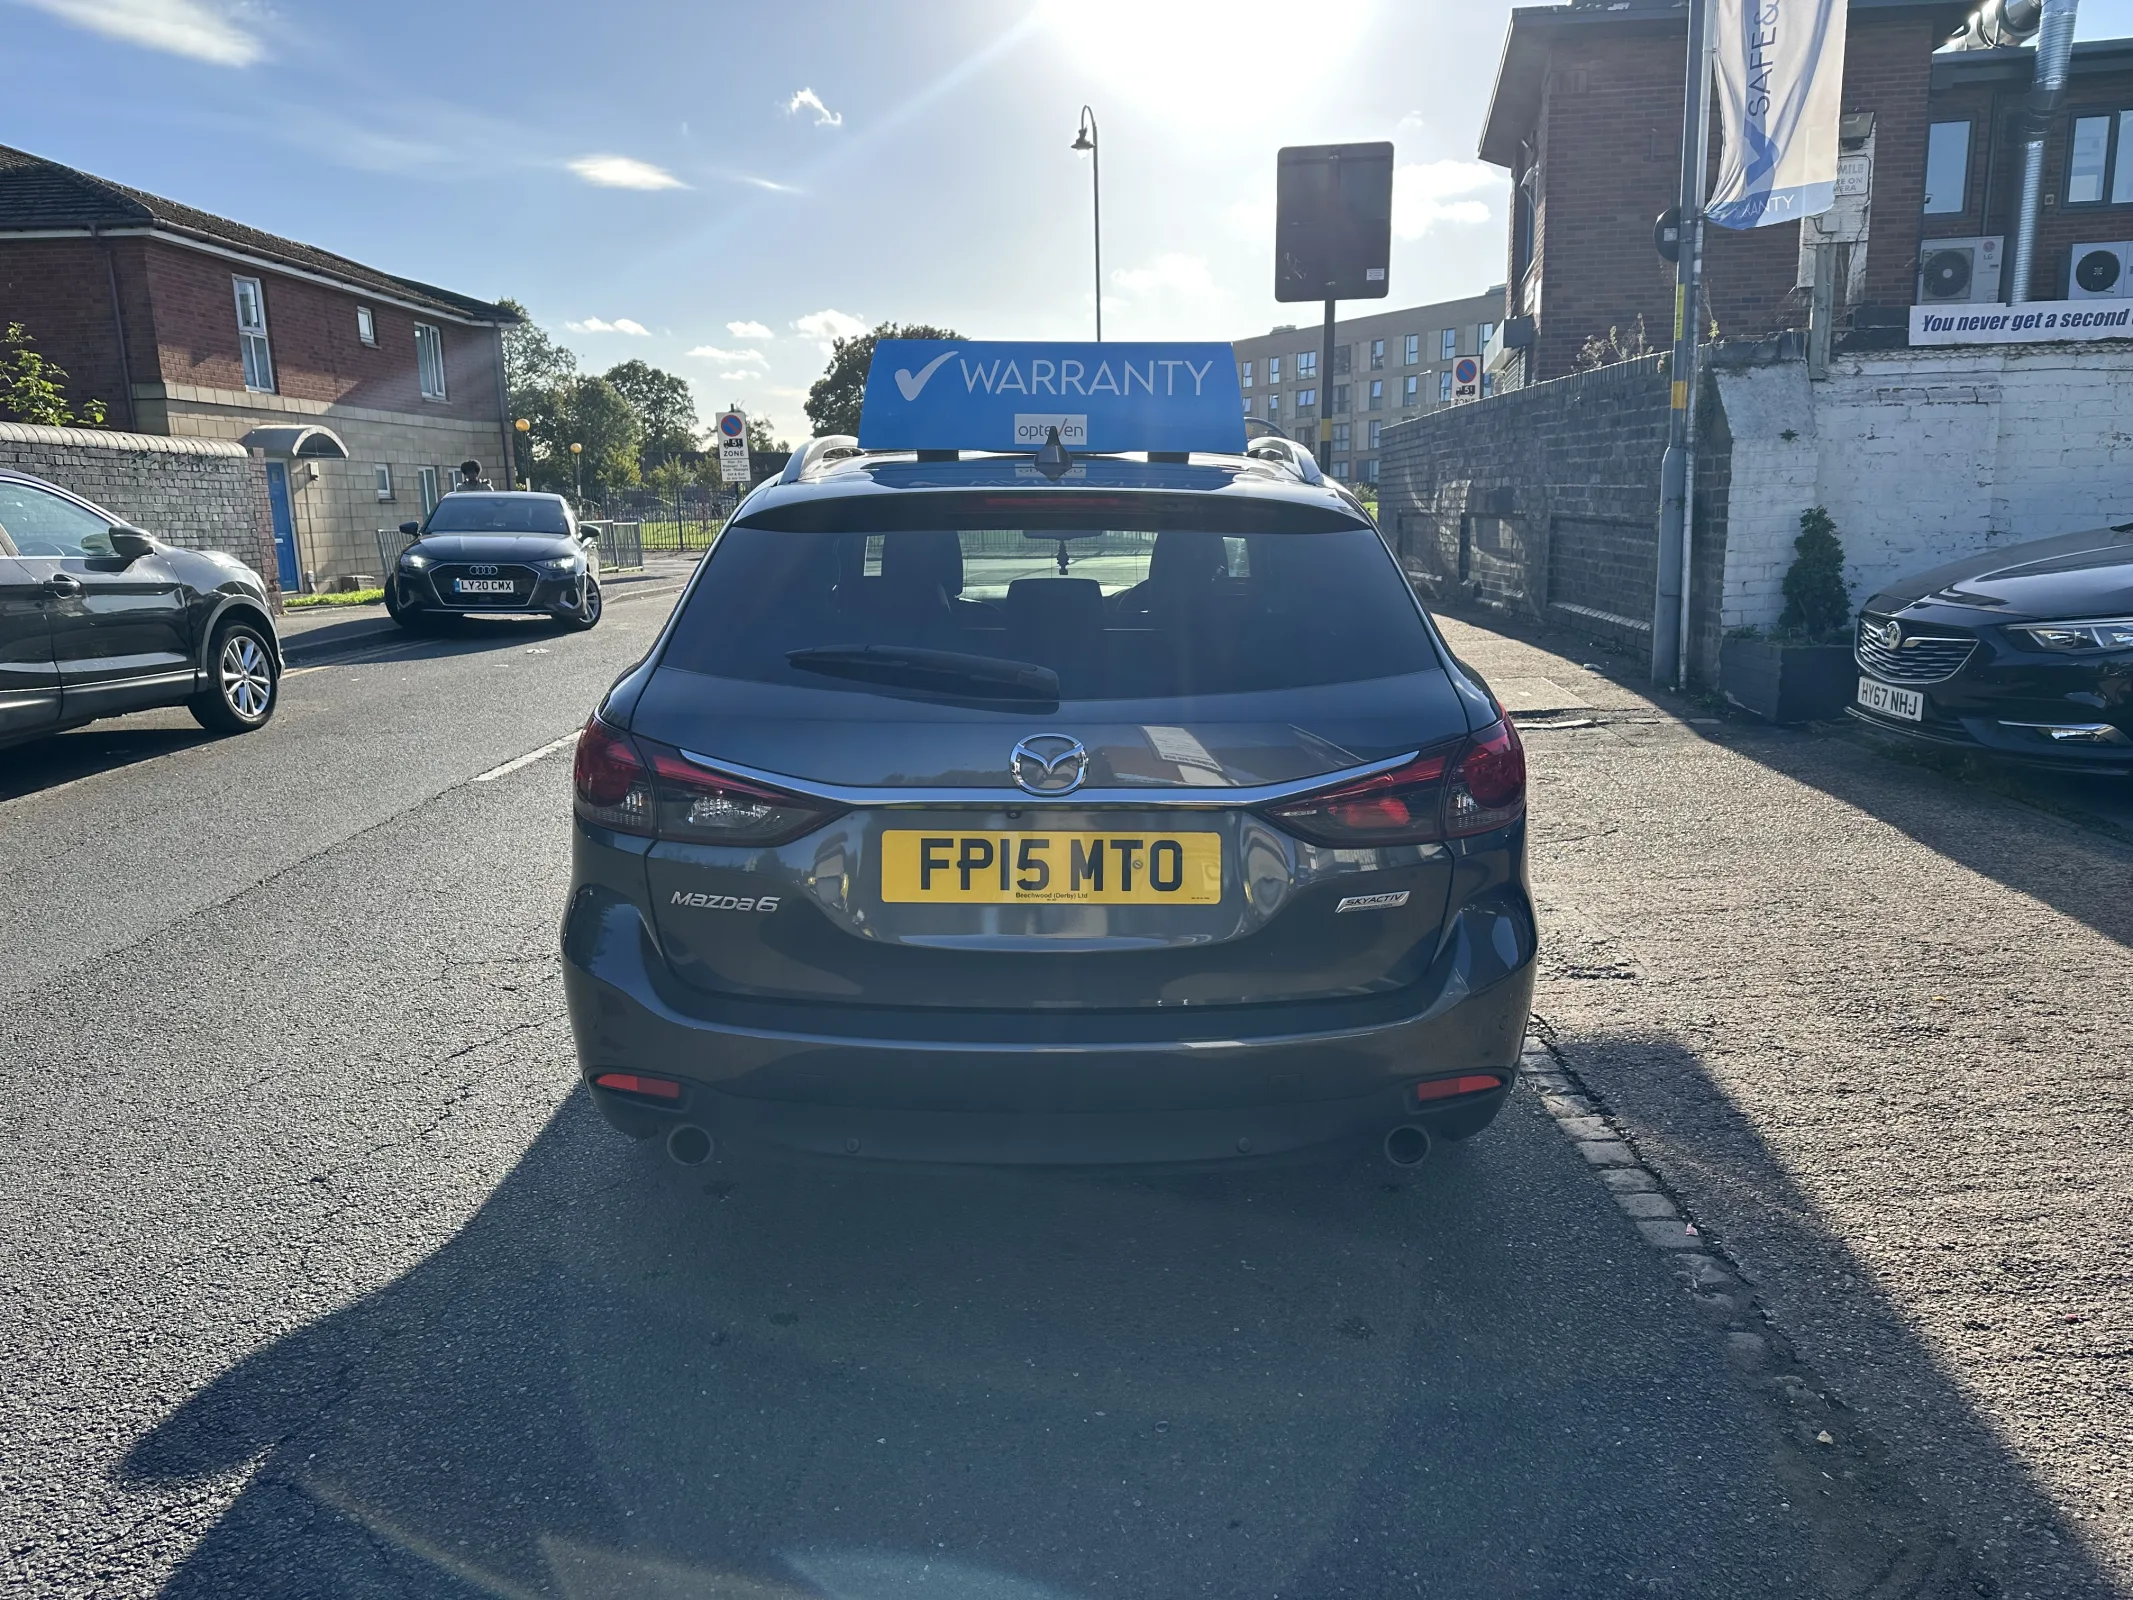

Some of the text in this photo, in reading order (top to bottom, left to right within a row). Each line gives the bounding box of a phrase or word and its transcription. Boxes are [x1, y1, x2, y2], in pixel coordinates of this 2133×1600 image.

[1837, 164, 1864, 174] MILE
[1923, 314, 1954, 332] You
[1956, 315, 2011, 331] never
[2010, 312, 2043, 331] get
[2045, 313, 2058, 328] a
[2060, 308, 2130, 327] second
[960, 358, 1214, 396] WARRANTY
[461, 581, 512, 591] LY20 CMX
[1861, 682, 1918, 716] HY67 NHJ
[920, 838, 1183, 892] FP15 MTO
[1053, 892, 1076, 900] (Derby)
[1346, 894, 1402, 905] SKYACTIV
